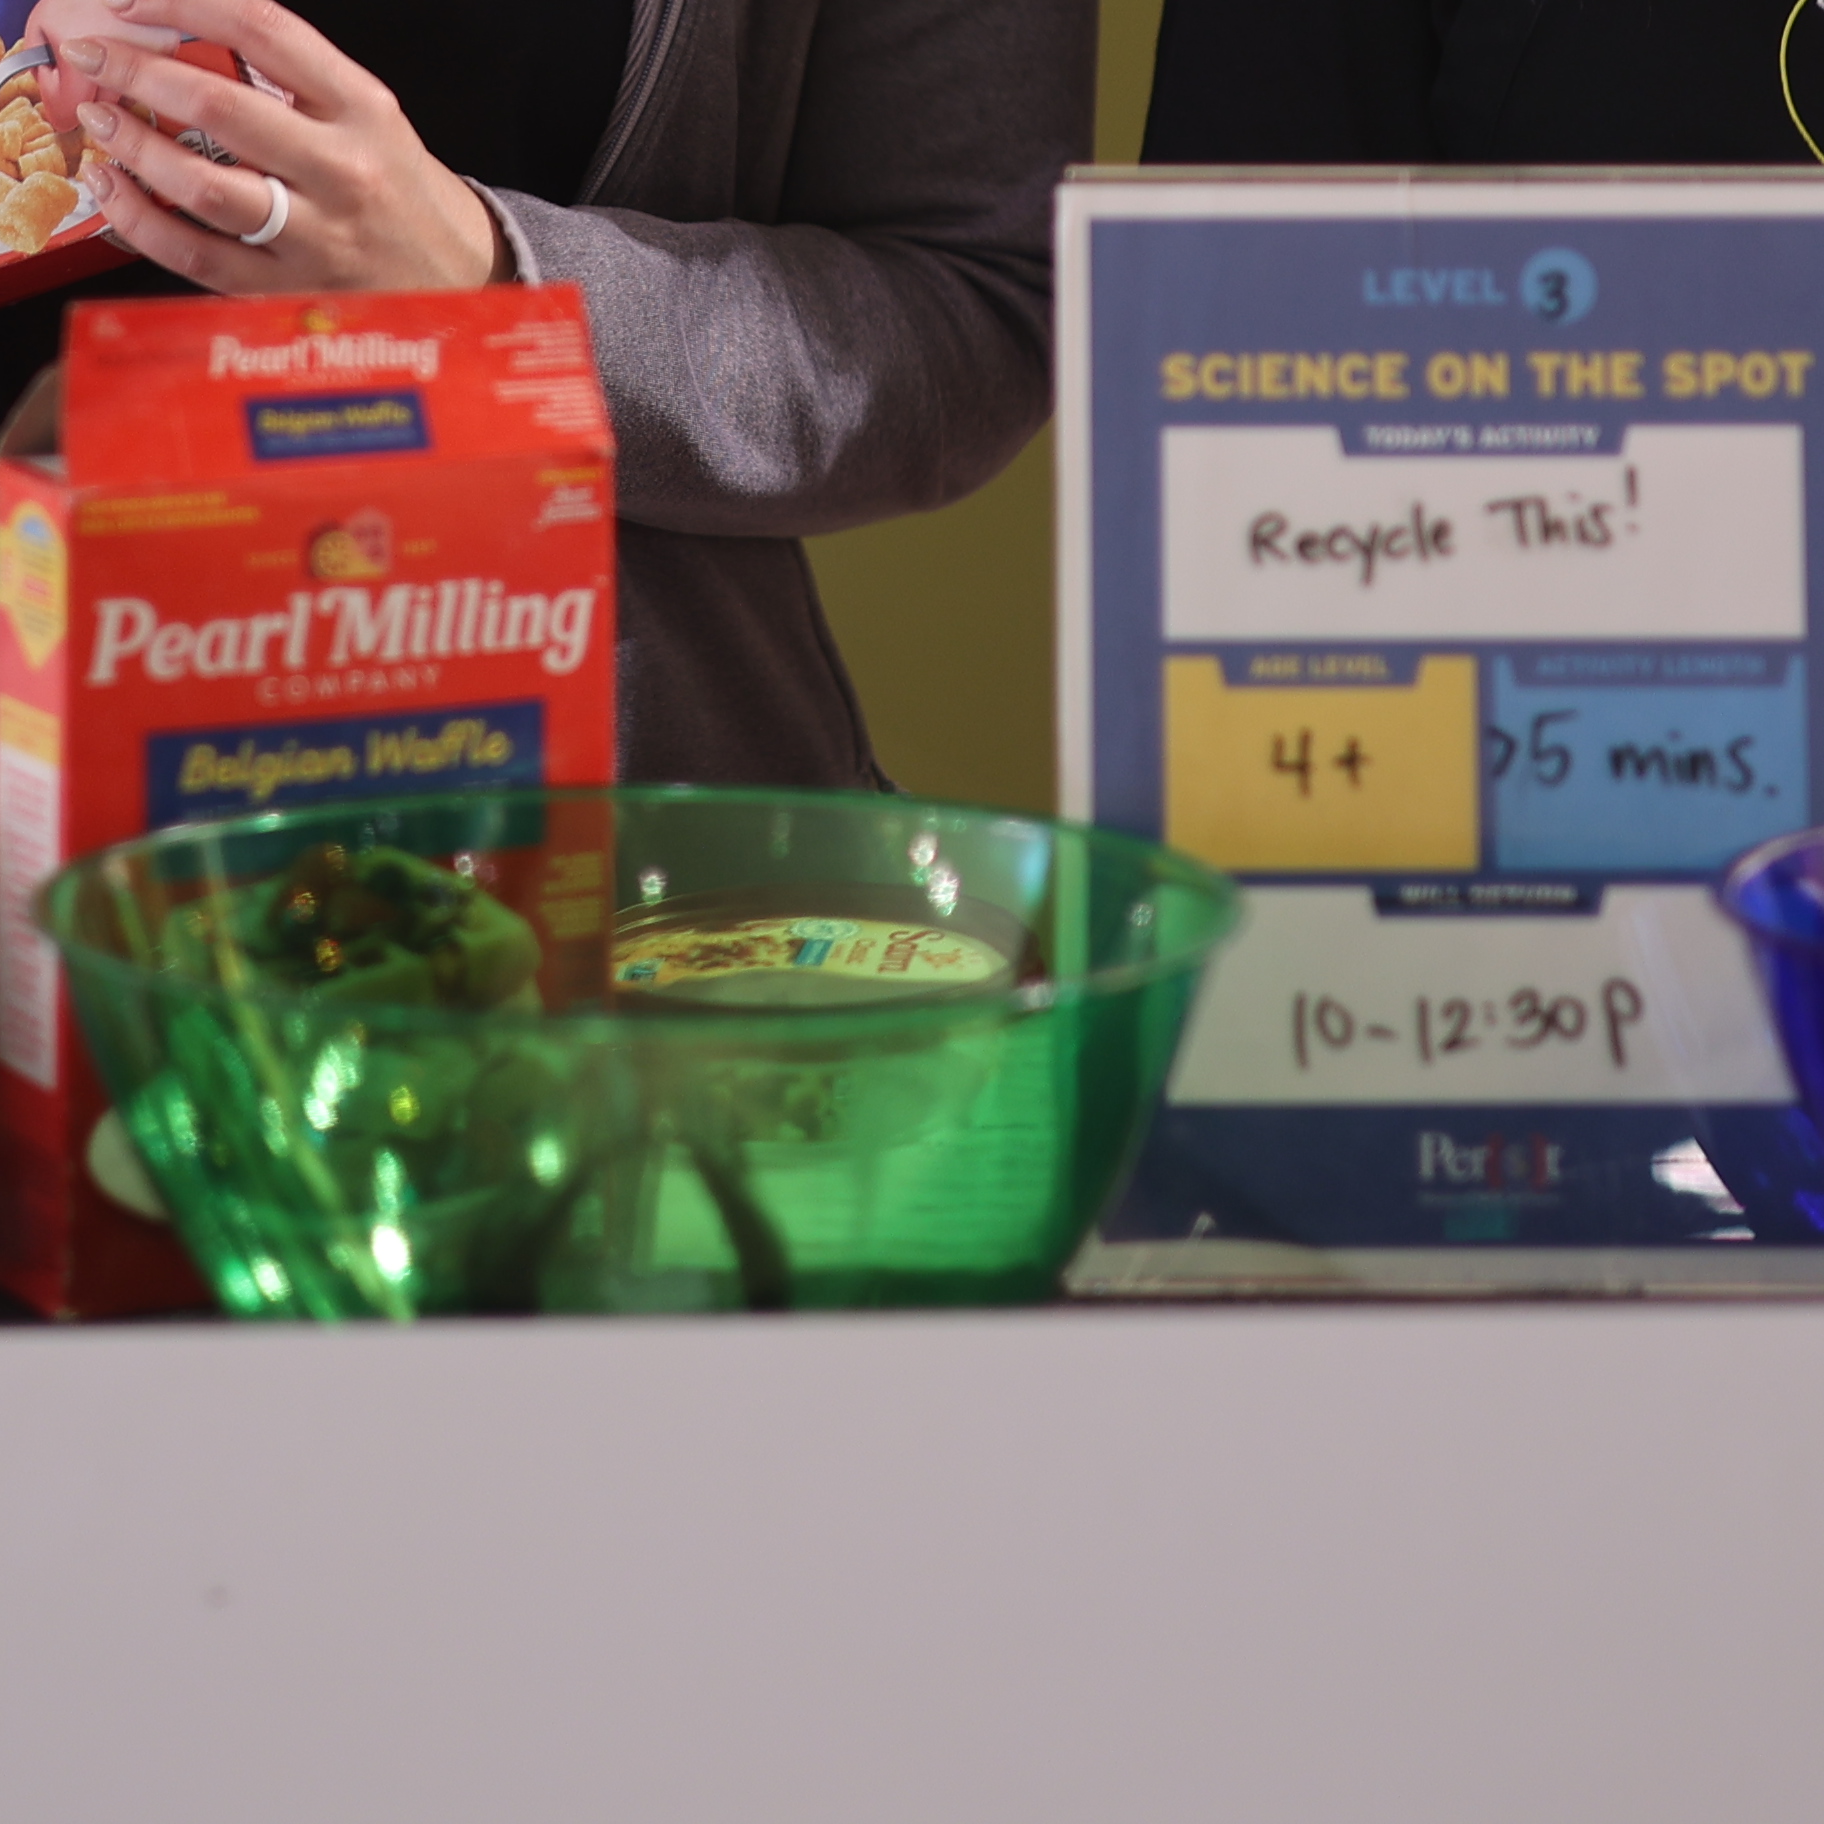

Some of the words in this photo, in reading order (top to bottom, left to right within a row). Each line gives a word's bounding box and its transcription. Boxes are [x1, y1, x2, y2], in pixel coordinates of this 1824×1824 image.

[1362, 267, 1508, 306] LEVEL
[1161, 351, 1409, 400] SCIENCE
[1425, 350, 1512, 401] ON
[1526, 350, 1647, 401] THE
[1662, 350, 1814, 399] SPOT
[1246, 502, 1458, 590] Recycle
[1484, 463, 1643, 555] This!
[86, 590, 315, 688] Pearl
[314, 577, 597, 675] Milling
[254, 663, 443, 708] COMPANY
[178, 737, 359, 806] Belgian
[364, 717, 516, 777] Waffle
